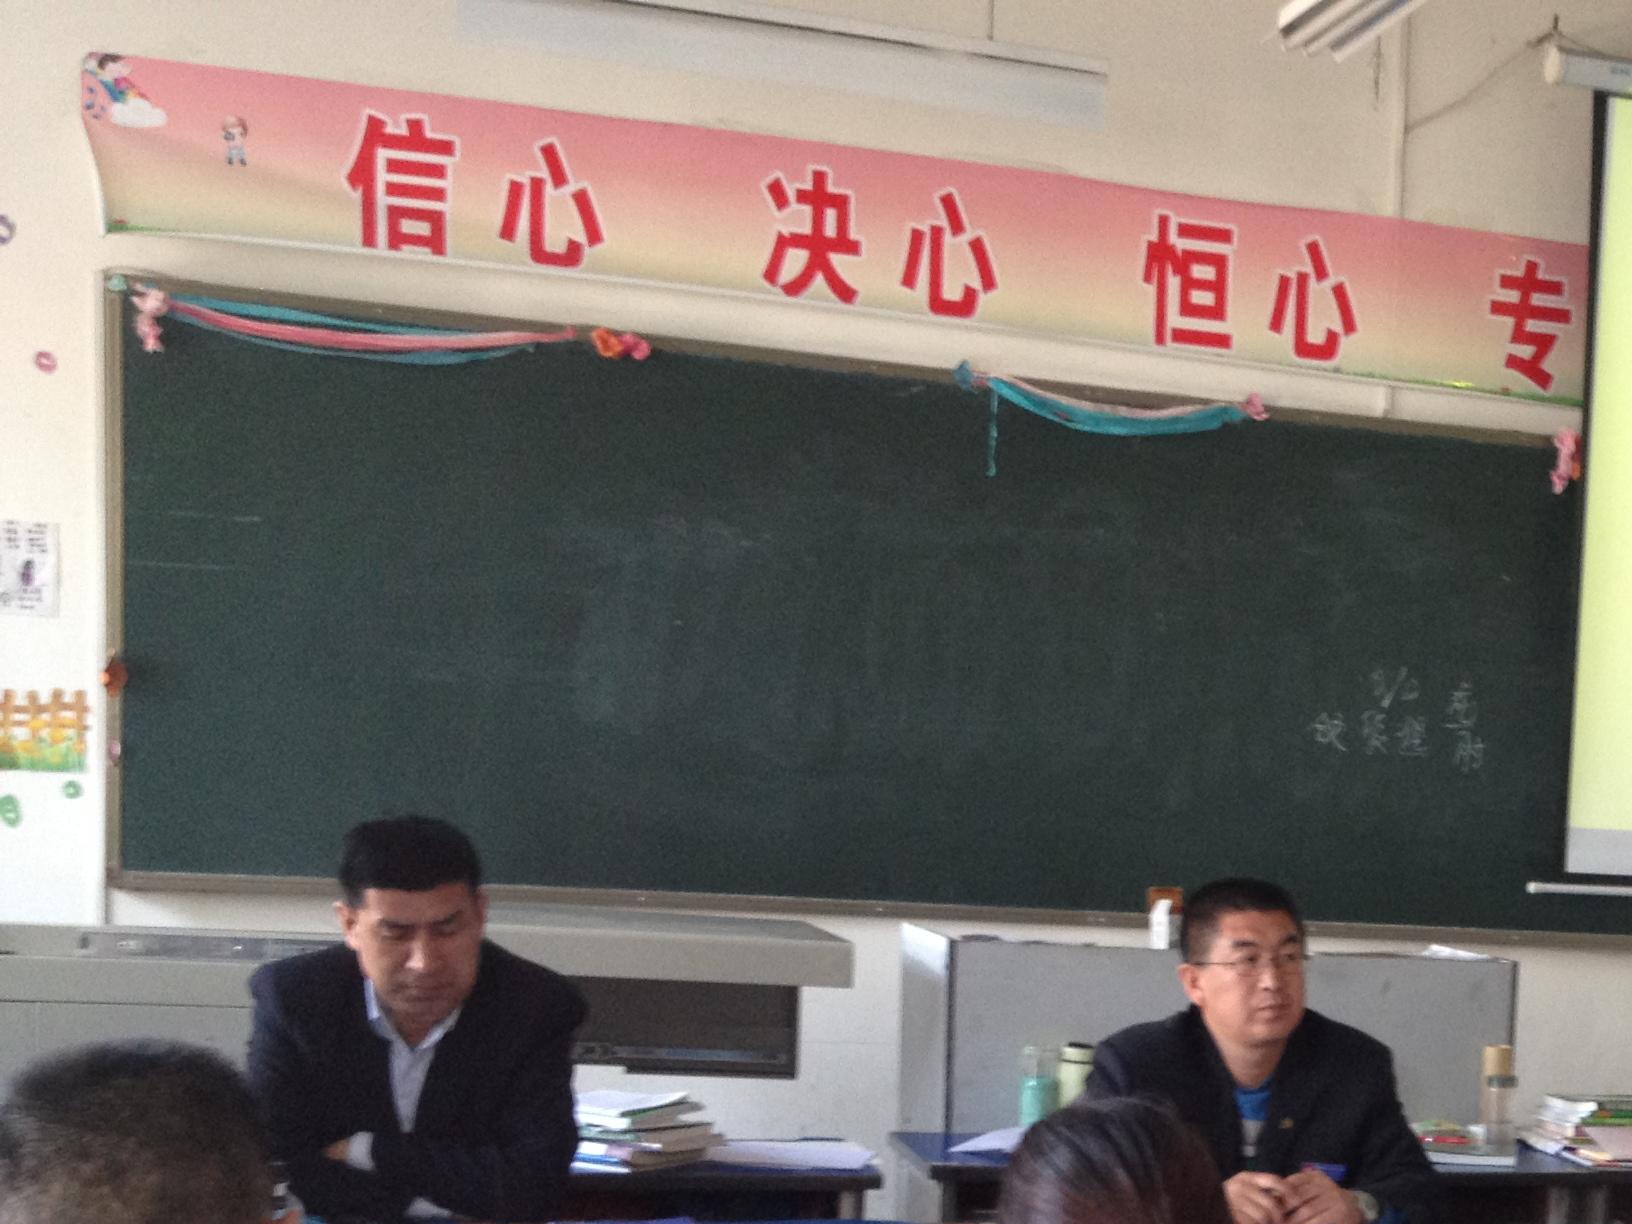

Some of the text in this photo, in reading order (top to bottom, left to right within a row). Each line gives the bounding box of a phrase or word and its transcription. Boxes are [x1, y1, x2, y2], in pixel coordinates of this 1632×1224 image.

[343, 112, 605, 268] 信心
[761, 166, 999, 319] 决心
[1142, 213, 1358, 361] 恒心
